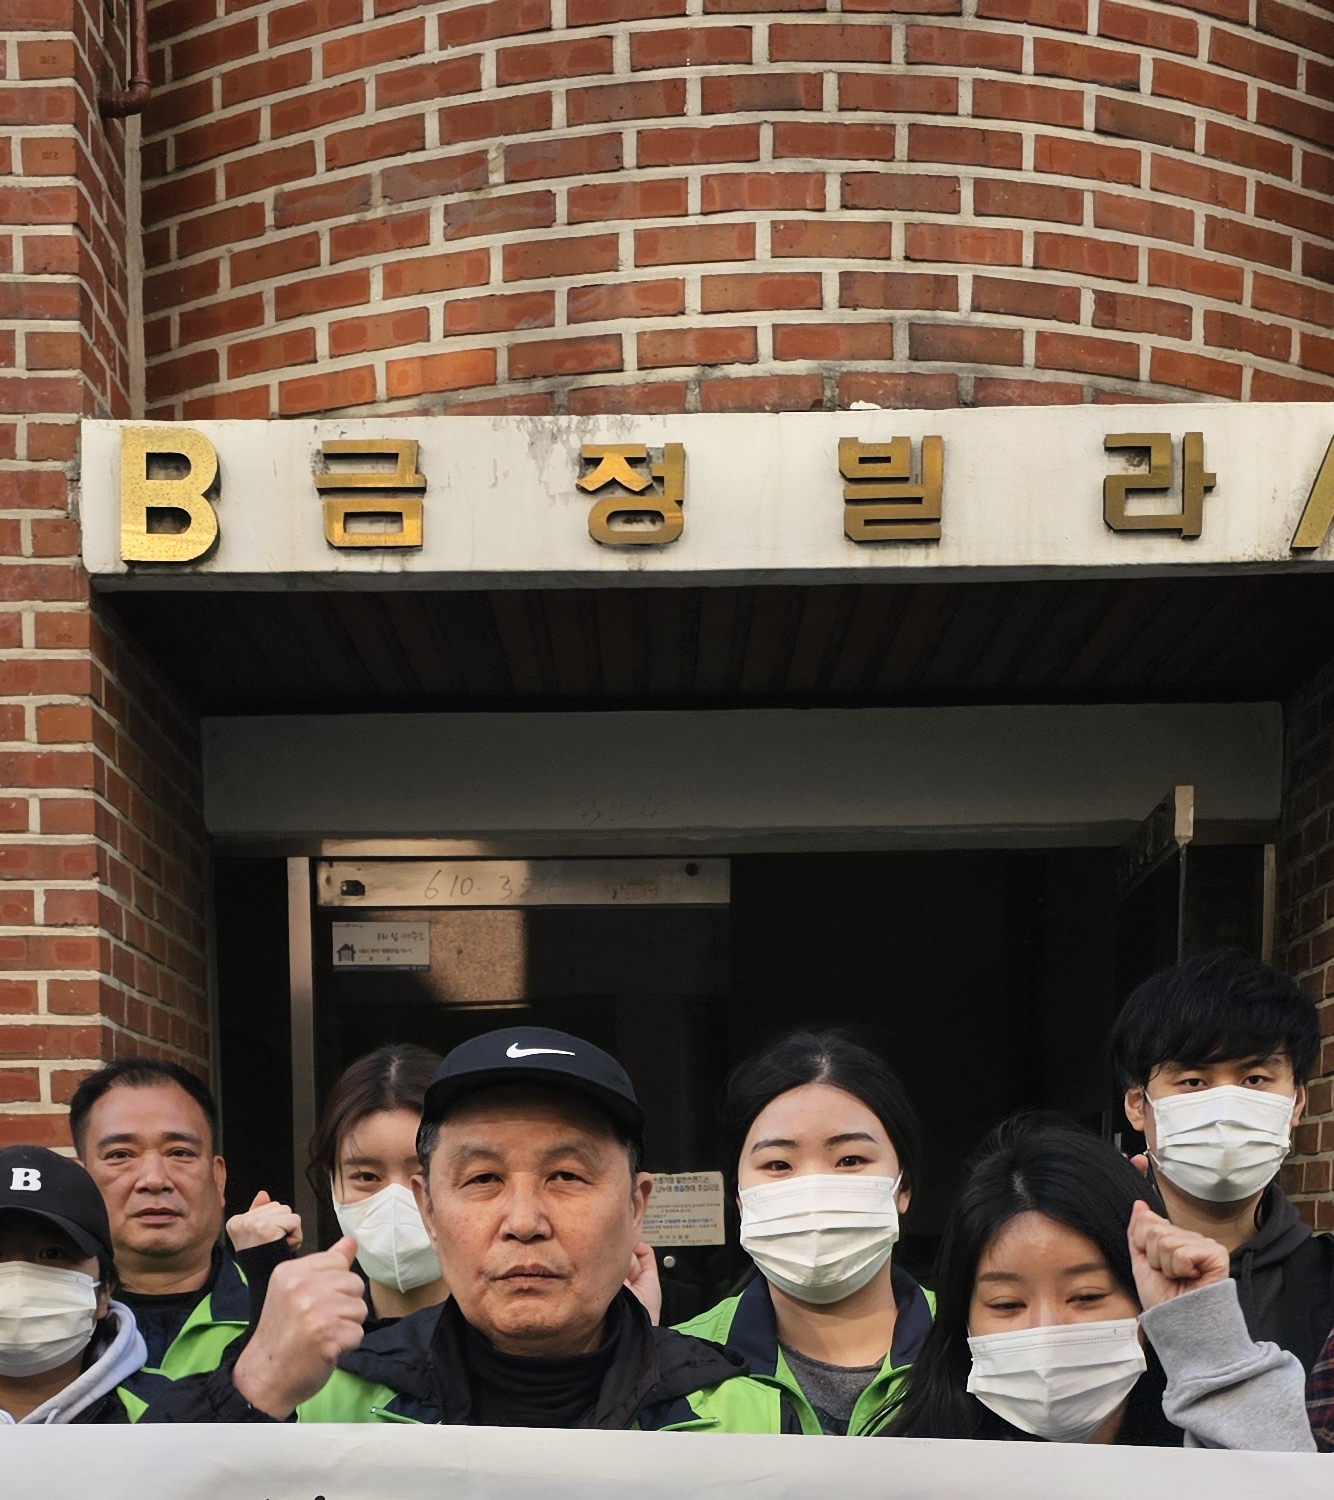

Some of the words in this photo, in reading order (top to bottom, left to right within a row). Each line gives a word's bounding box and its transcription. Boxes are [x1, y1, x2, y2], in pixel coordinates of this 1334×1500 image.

[119, 425, 221, 566] B
[312, 431, 1217, 550] 금정빌라
[9, 1167, 42, 1191] B
